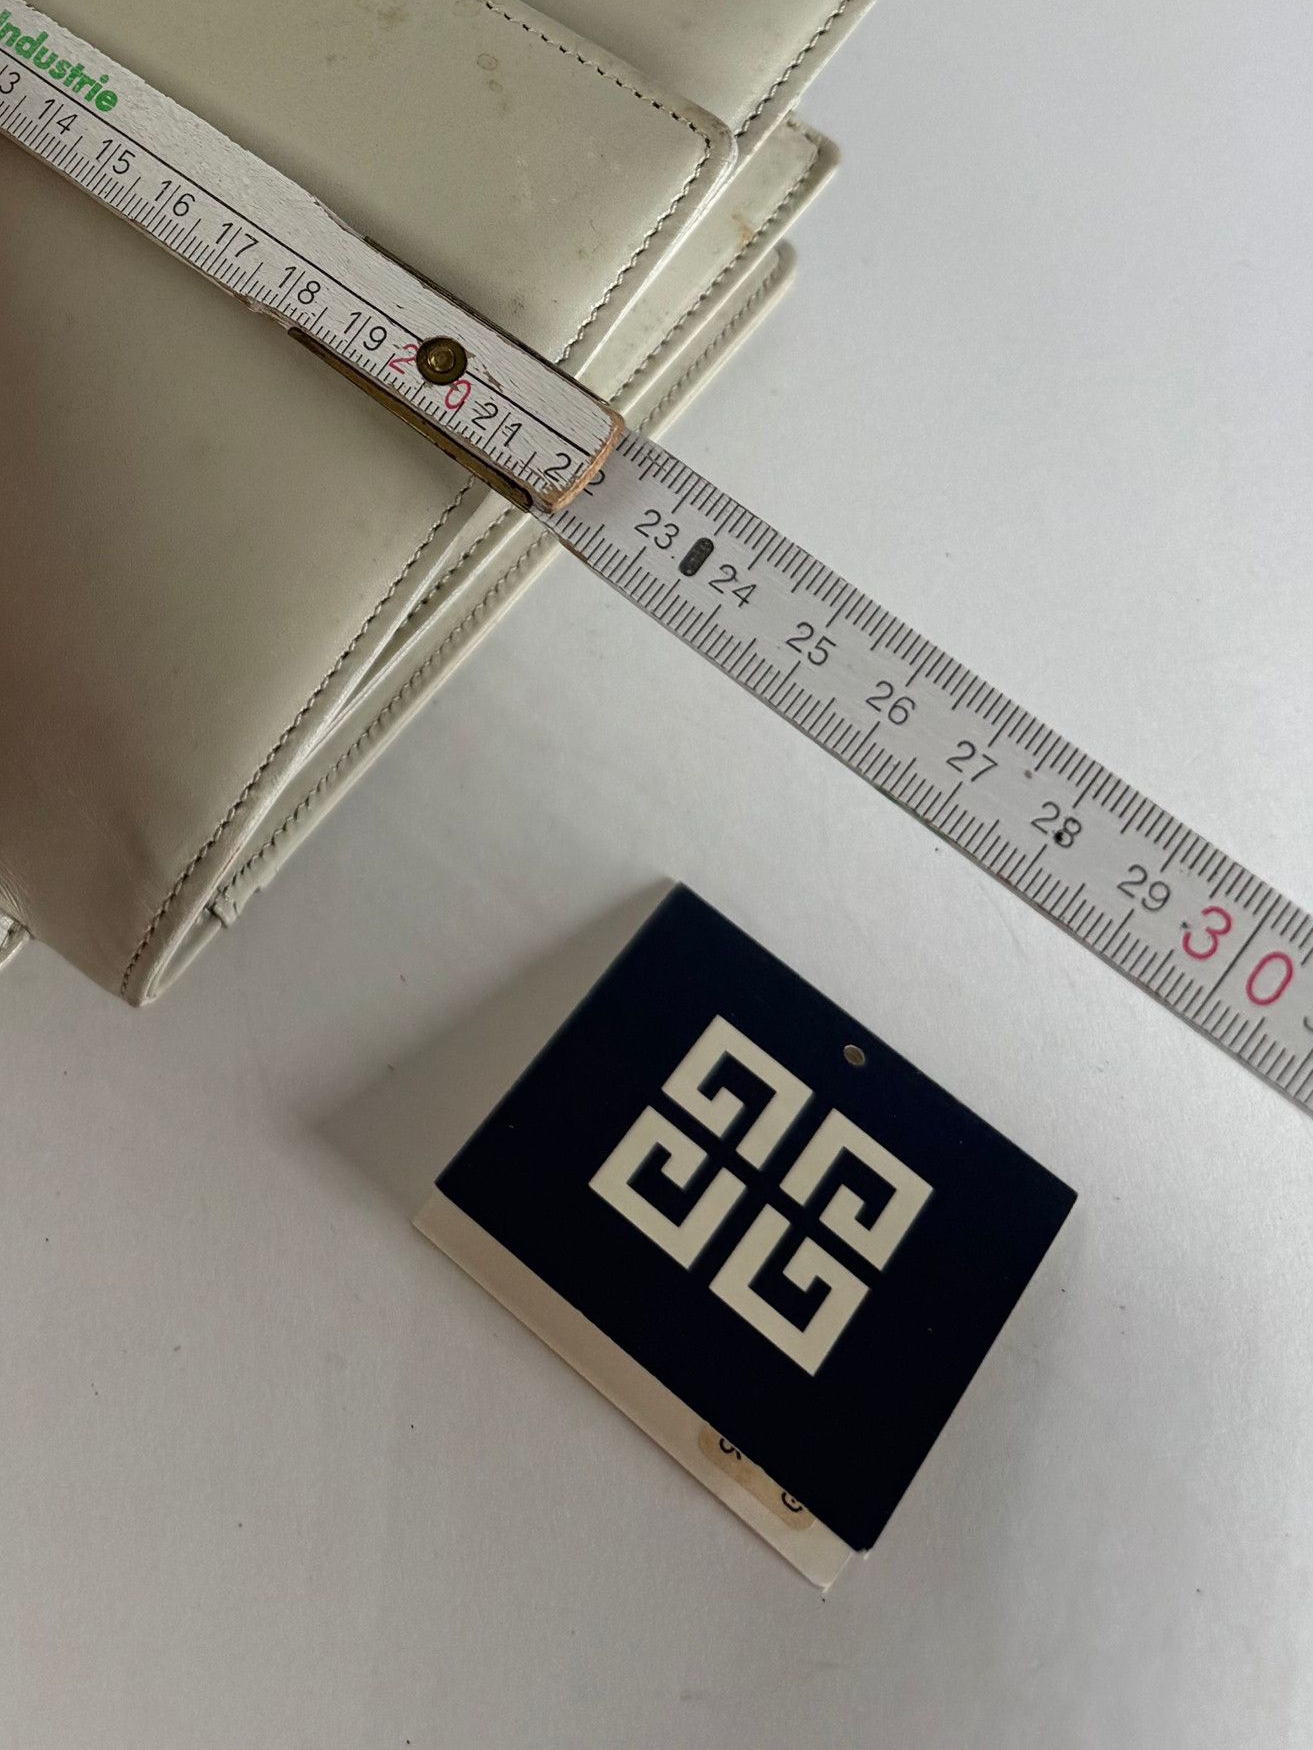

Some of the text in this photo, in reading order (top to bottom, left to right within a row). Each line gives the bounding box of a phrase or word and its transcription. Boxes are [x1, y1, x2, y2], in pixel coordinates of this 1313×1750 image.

[38, 98, 79, 136] 14
[95, 138, 137, 176] 15
[157, 178, 197, 218] 16
[220, 221, 260, 260] 17
[283, 264, 323, 306] 18
[344, 309, 389, 352] 19
[470, 402, 524, 448] 21
[633, 507, 1295, 1007] 23 24 25 26 27 28 29 30
